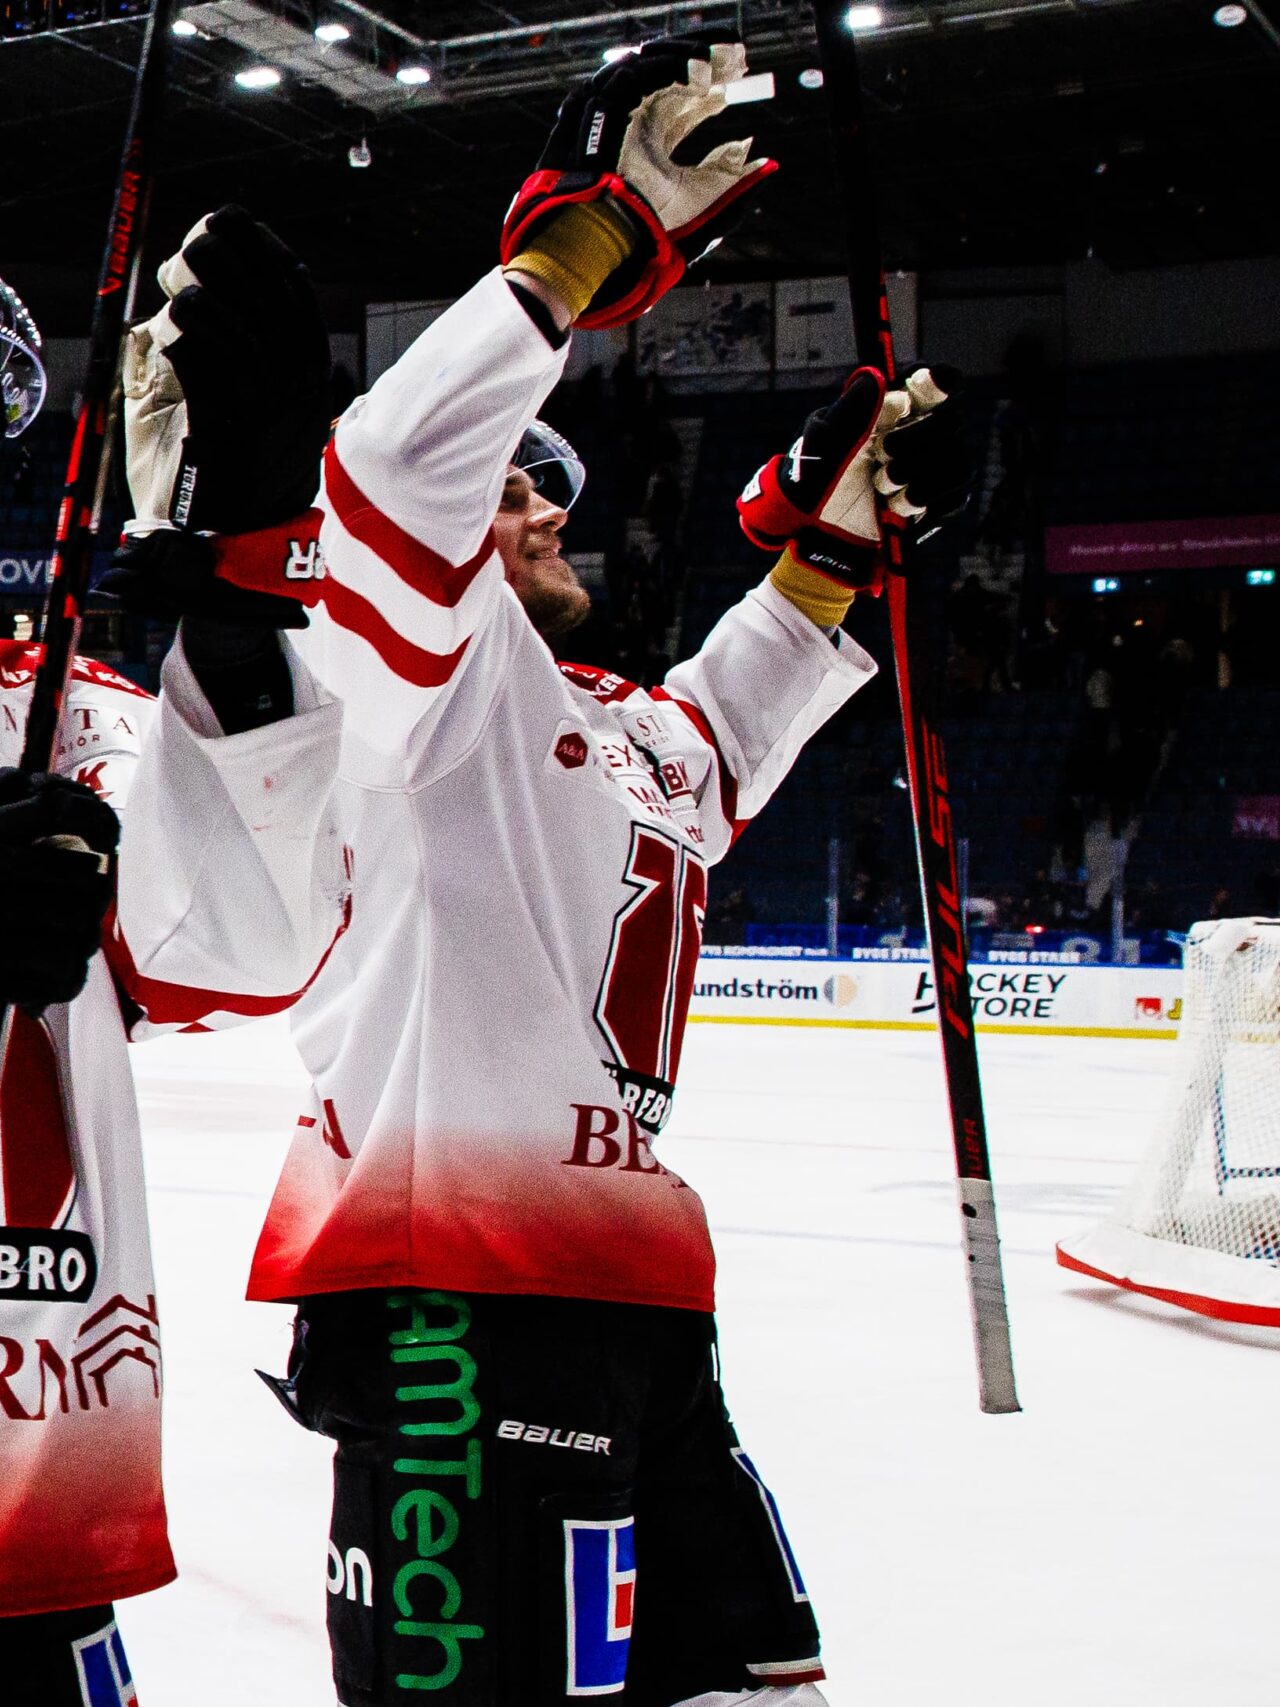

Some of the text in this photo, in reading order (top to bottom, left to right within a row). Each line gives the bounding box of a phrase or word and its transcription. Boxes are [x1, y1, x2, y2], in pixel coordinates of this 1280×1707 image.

[693, 977, 818, 1001] undström
[915, 971, 1067, 1000] HCKEY
[497, 1419, 611, 1456] BAUER
